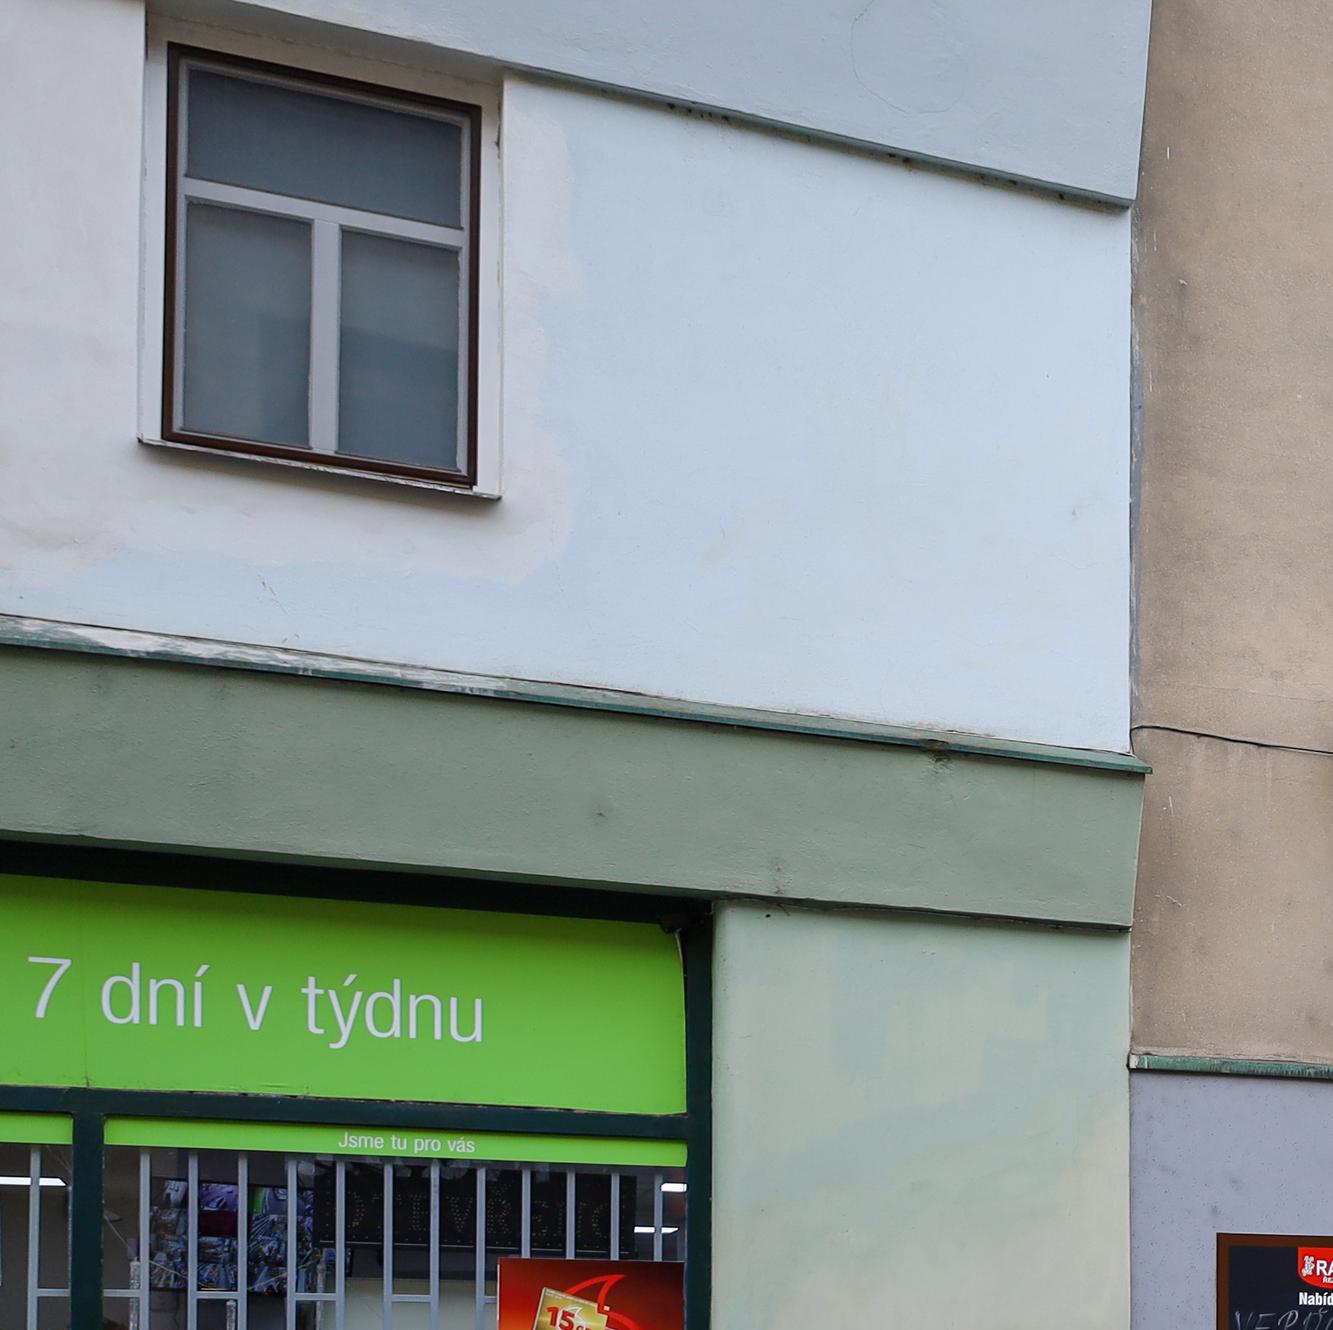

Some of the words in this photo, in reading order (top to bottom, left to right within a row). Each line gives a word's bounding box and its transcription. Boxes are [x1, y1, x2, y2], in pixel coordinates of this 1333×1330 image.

[27, 957, 72, 1019] 7
[101, 962, 210, 1028] dní
[236, 984, 272, 1031] v
[301, 974, 484, 1050] týdnu
[338, 1132, 384, 1150] Jsme
[390, 1134, 408, 1151] tu
[414, 1138, 442, 1155] pro
[447, 1135, 476, 1153] vás
